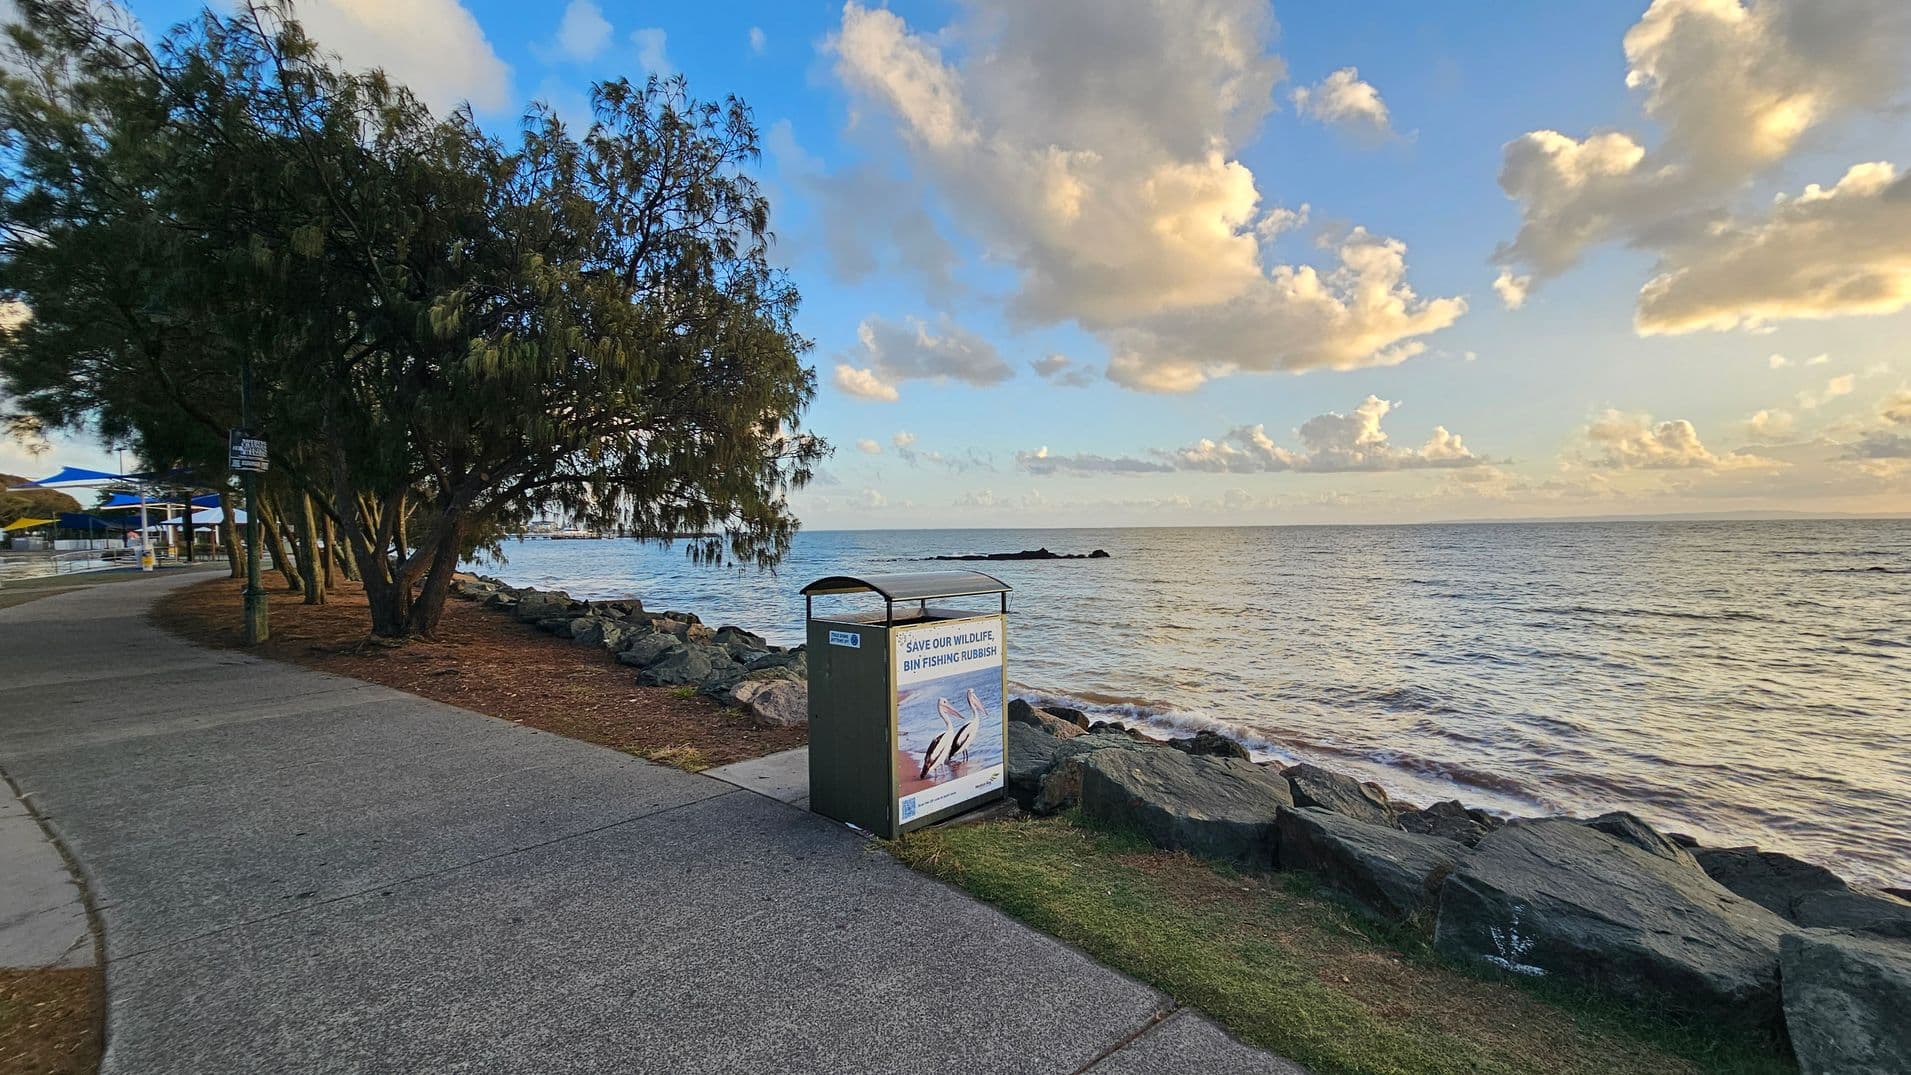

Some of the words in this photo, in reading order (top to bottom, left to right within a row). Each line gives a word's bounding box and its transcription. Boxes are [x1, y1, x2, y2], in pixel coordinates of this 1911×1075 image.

[906, 640, 931, 653] SAVE
[933, 636, 952, 649] OUR
[953, 630, 995, 646] WILDLIFE,
[904, 659, 921, 671] BIN
[922, 652, 960, 668] FISHING
[961, 646, 997, 661] RUBBISH
